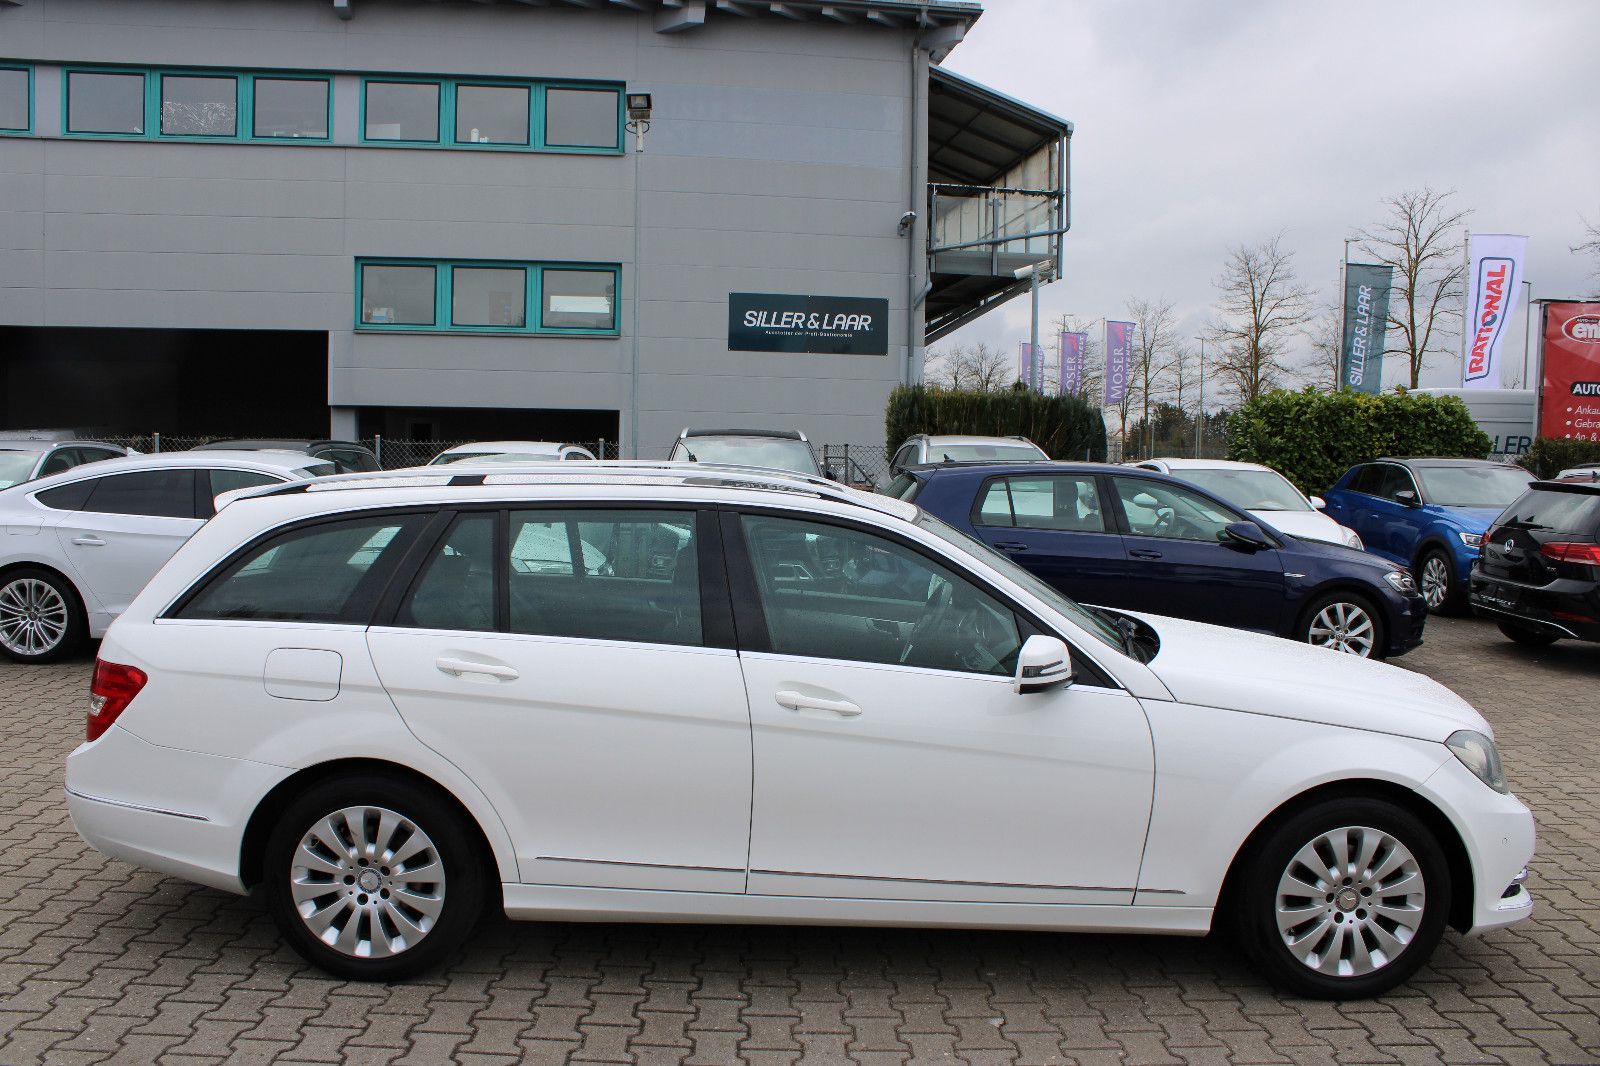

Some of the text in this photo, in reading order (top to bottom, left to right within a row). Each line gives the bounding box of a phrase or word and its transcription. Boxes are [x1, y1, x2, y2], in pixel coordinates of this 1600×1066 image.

[743, 310, 806, 329] SILLER
[822, 313, 872, 331] LAAR
[1356, 284, 1372, 326] LAAR
[1468, 264, 1506, 374] RATIONAL
[1065, 355, 1077, 391] OSER
[1110, 347, 1124, 400] MOSER
[1349, 336, 1367, 386] SILLER
[1492, 434, 1532, 455] LER
